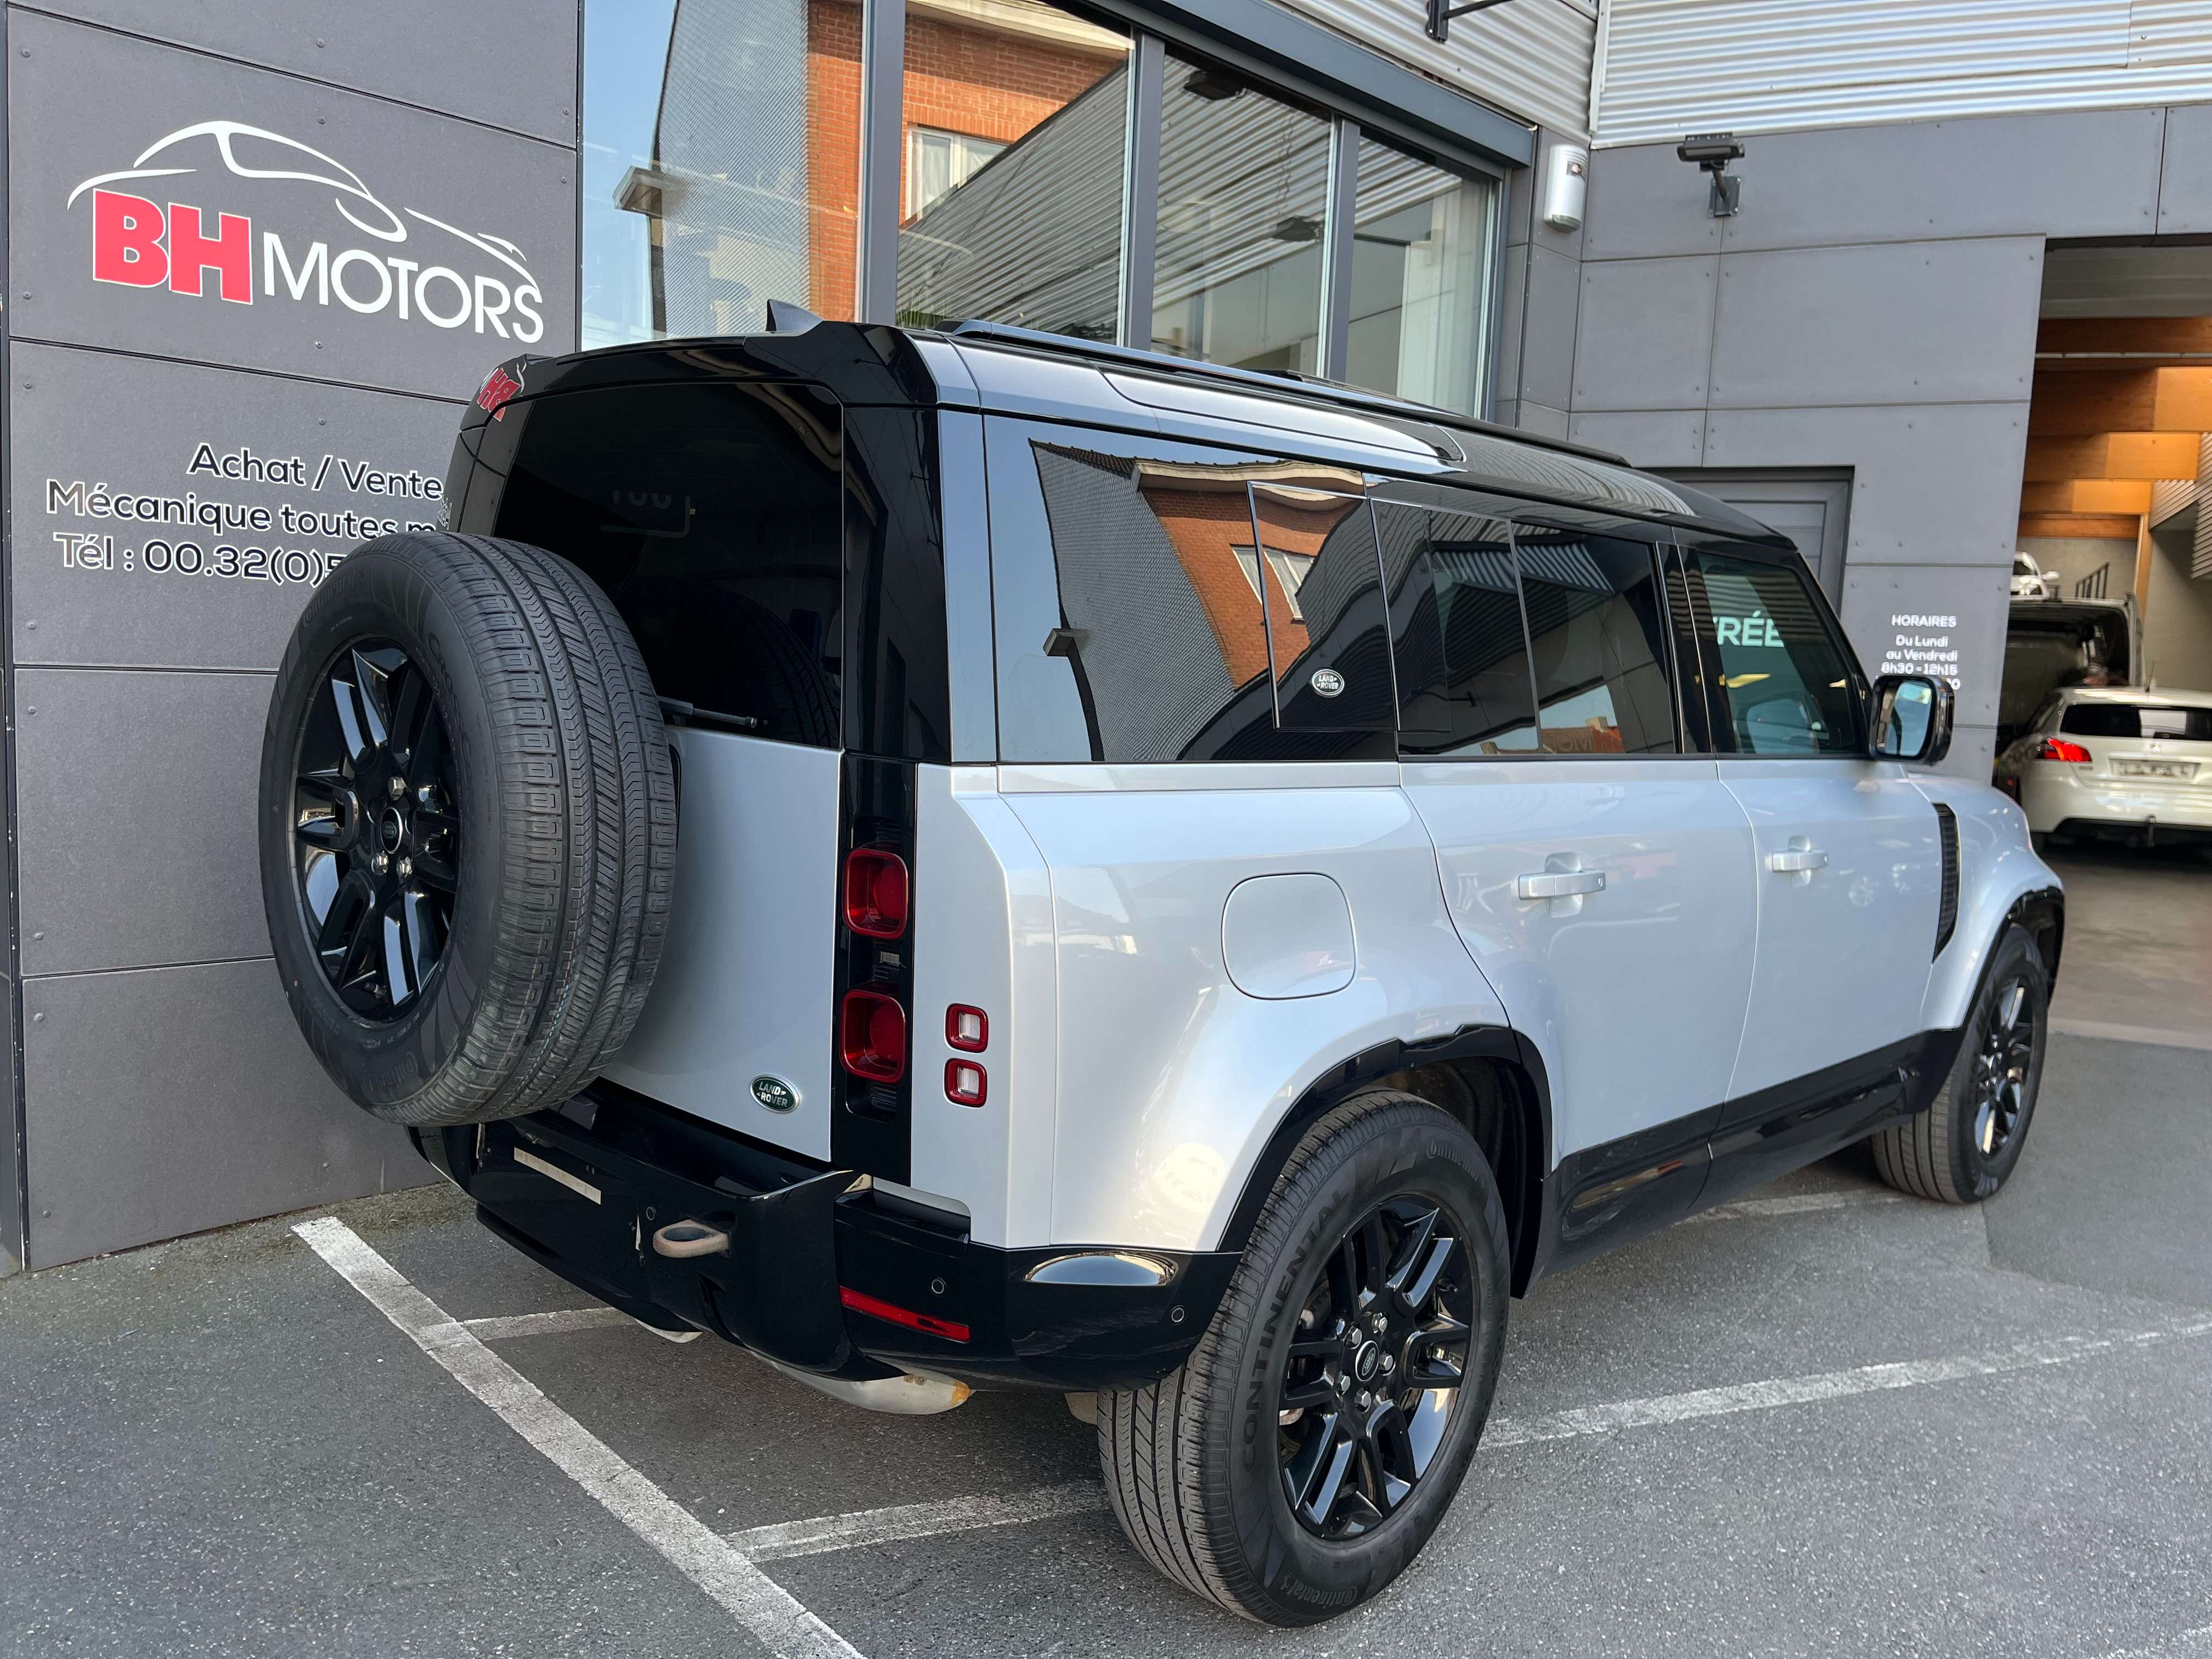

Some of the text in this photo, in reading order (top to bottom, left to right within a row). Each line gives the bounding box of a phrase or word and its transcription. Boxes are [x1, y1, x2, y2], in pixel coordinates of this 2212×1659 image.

[93, 188, 544, 343] BH MOTORS
[187, 442, 443, 500] Achat / Vente
[46, 478, 272, 535] Mécanique
[278, 503, 398, 541] toutes
[53, 531, 114, 570] Tél
[1712, 610, 1785, 648] RÉE
[1891, 614, 1957, 628] HORAIRES
[1895, 634, 1949, 648] Du Lundi
[1881, 662, 1914, 674] 8h30
[1904, 648, 1958, 662] Vendredi
[759, 1081, 781, 1095] LAND
[761, 1091, 788, 1107] ROVER
[1241, 1189, 1351, 1474] CONTINENTAL
